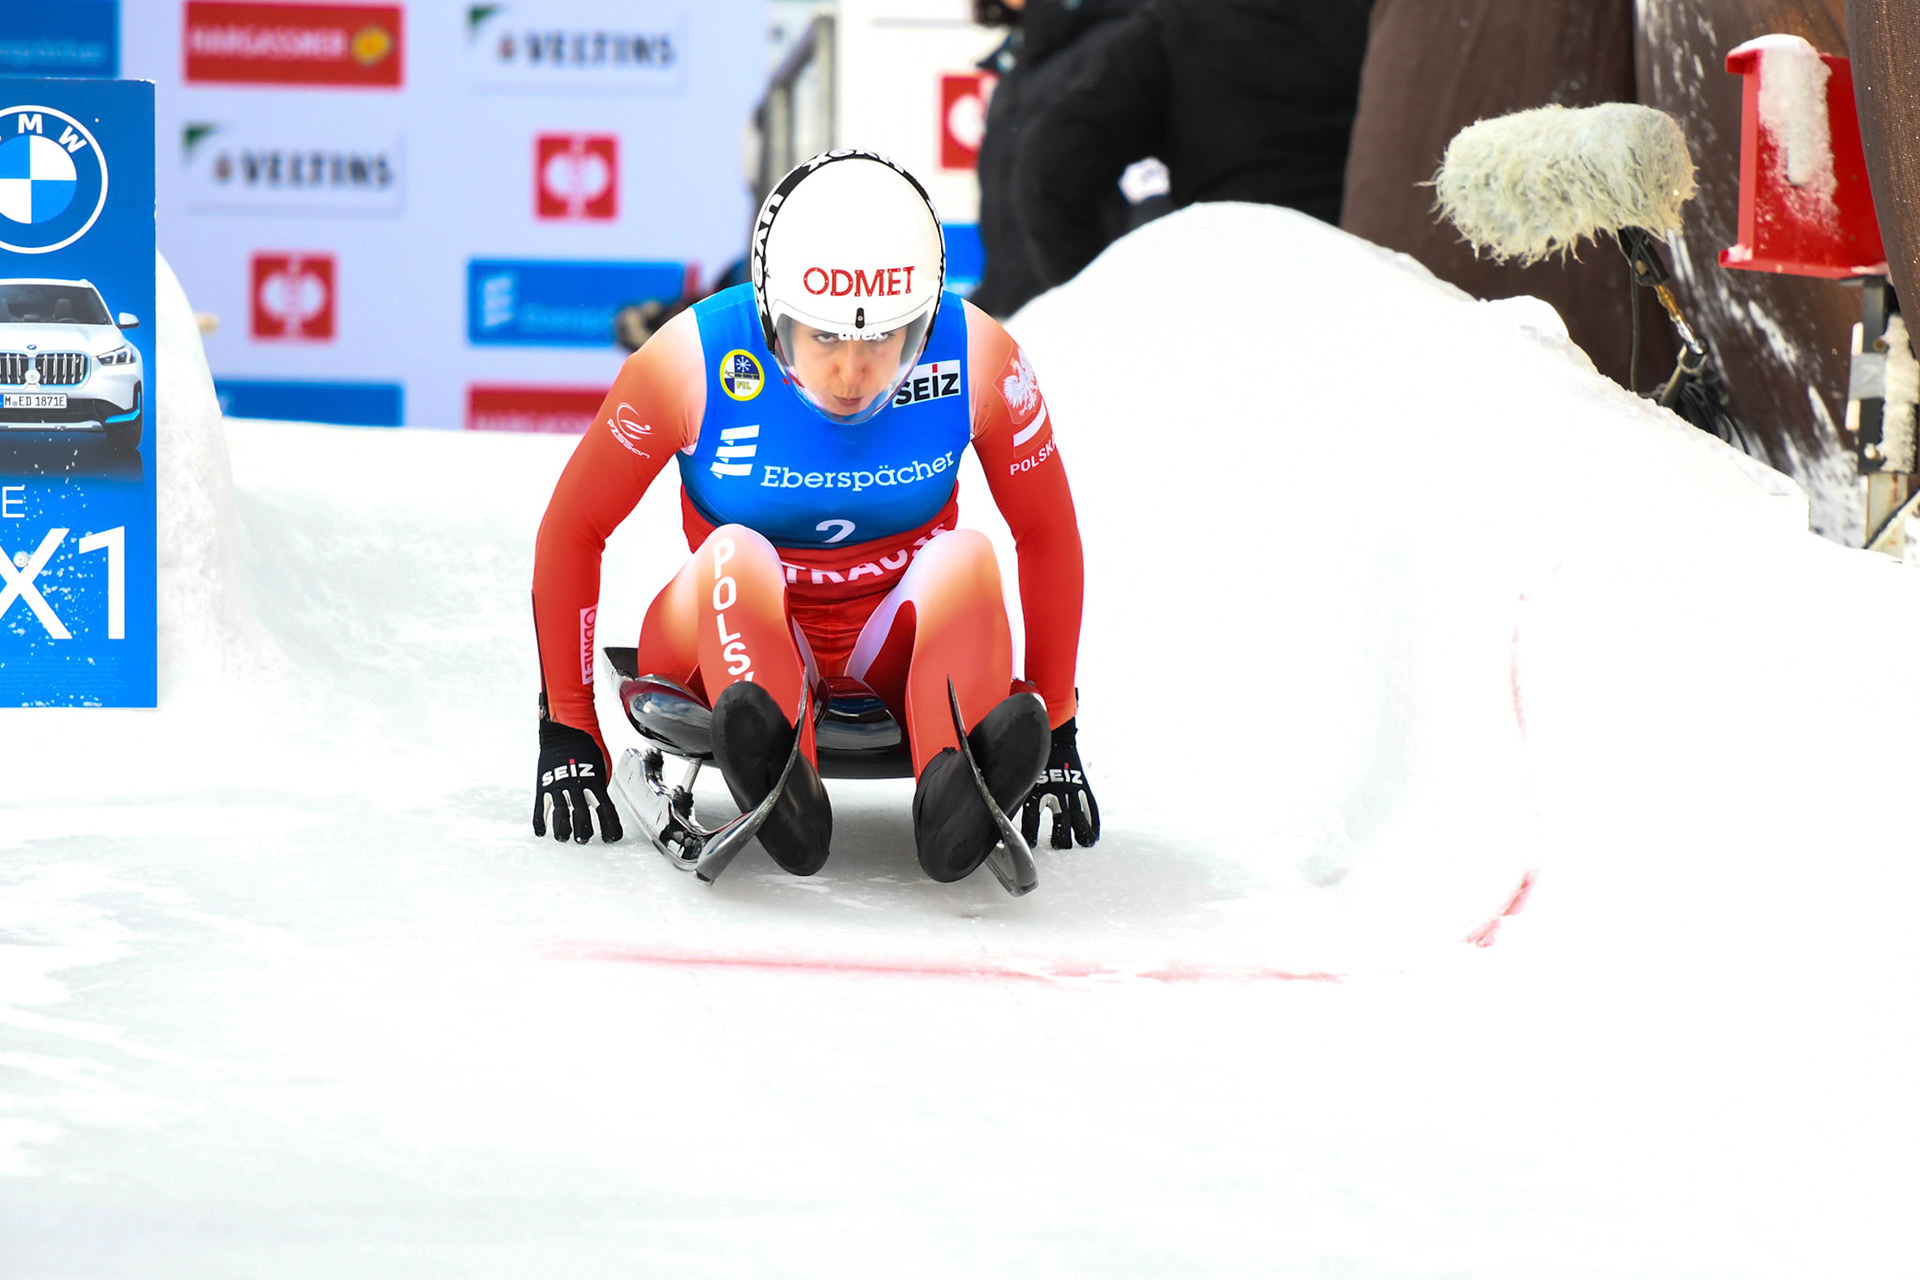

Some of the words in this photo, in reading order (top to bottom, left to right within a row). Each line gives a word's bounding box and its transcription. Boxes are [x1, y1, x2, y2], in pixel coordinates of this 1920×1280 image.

[525, 29, 676, 66] VELTINS
[0, 113, 87, 154] MW
[242, 150, 393, 189] VELTINS
[803, 265, 916, 297] ODMET
[18, 396, 32, 406] ED
[35, 396, 65, 406] 1871E
[736, 380, 752, 390] FIL
[760, 450, 955, 492] Eberspächer
[815, 518, 857, 544] 2
[712, 537, 755, 683] POLS
[583, 608, 597, 679] ODMET
